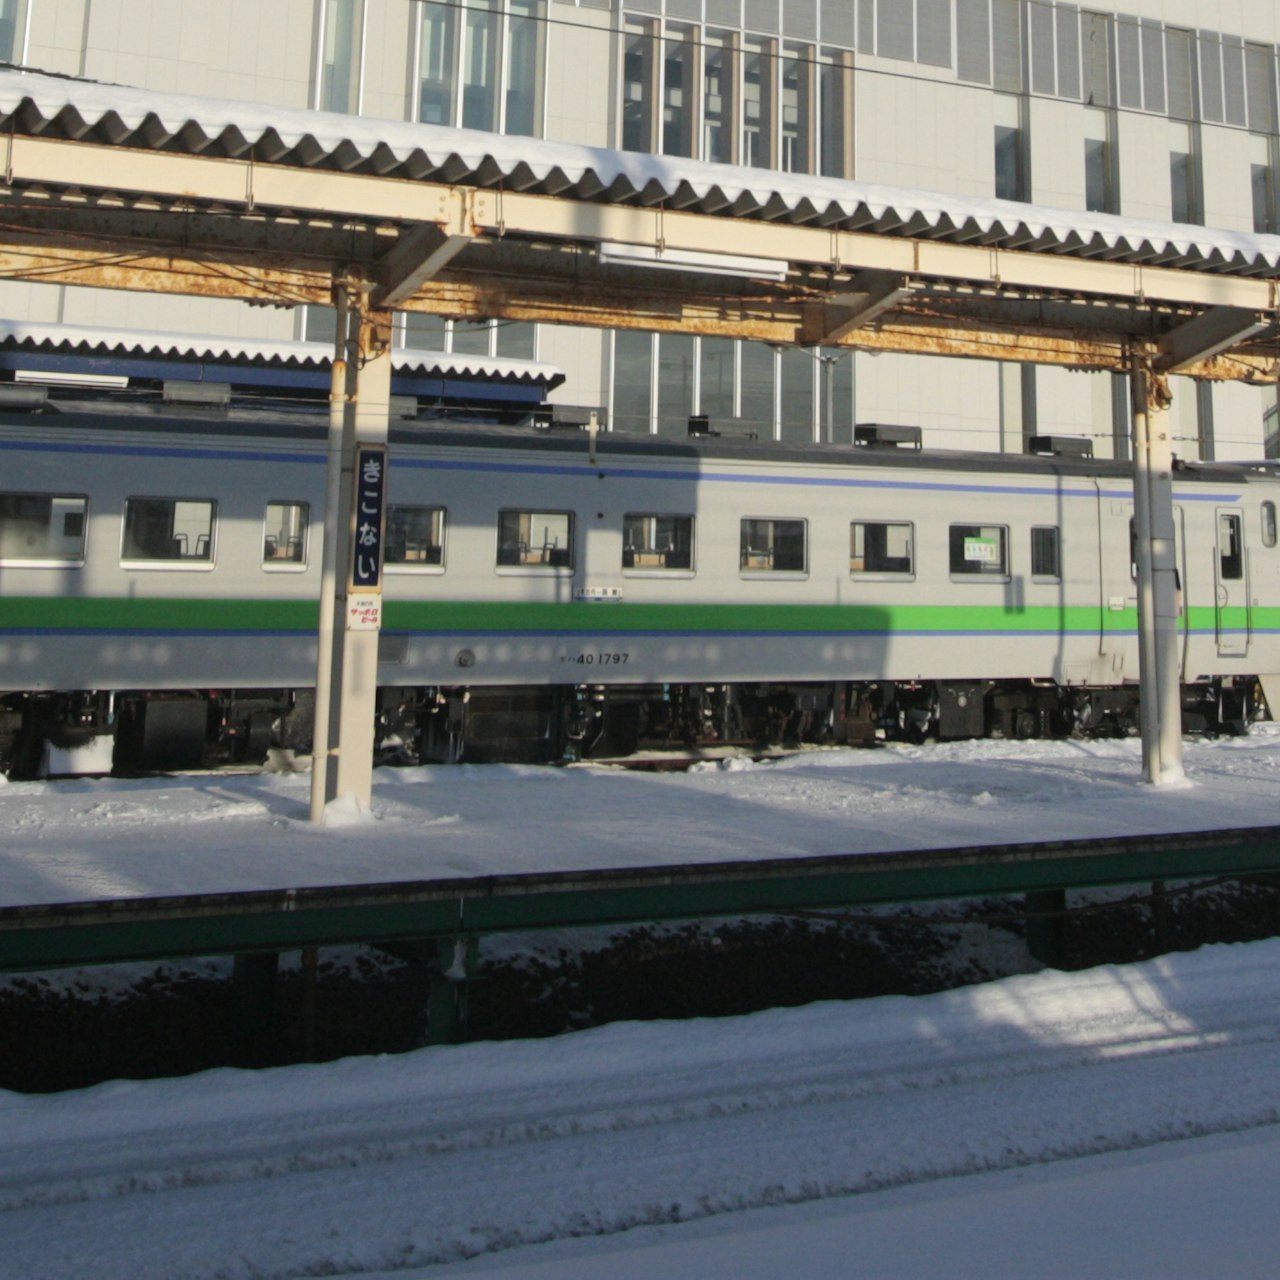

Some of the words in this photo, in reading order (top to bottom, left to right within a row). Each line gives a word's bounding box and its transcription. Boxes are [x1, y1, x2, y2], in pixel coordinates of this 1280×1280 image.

[357, 458, 381, 579] きこない
[598, 653, 630, 665] 1797
